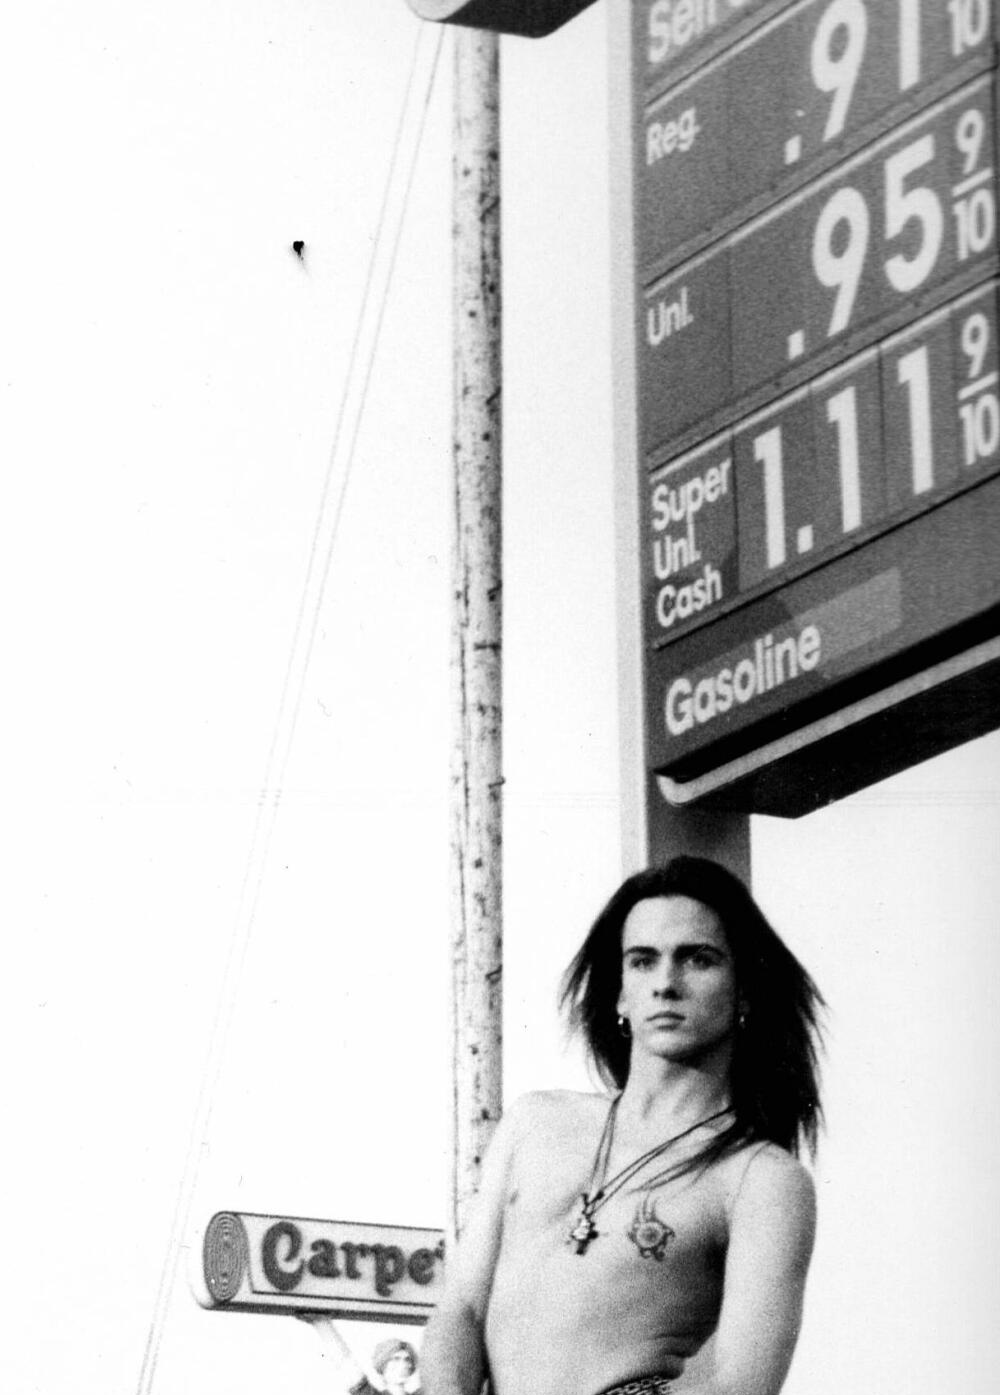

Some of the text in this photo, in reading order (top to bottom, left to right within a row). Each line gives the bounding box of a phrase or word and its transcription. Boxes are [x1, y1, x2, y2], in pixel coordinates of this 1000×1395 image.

[646, 107, 700, 166] Reg.
[786, 133, 944, 360] .95
[647, 286, 694, 346] Unl.
[652, 457, 731, 531] Super
[752, 345, 934, 570] 1.11
[657, 563, 722, 628] Cash
[664, 624, 822, 736] Gasoline
